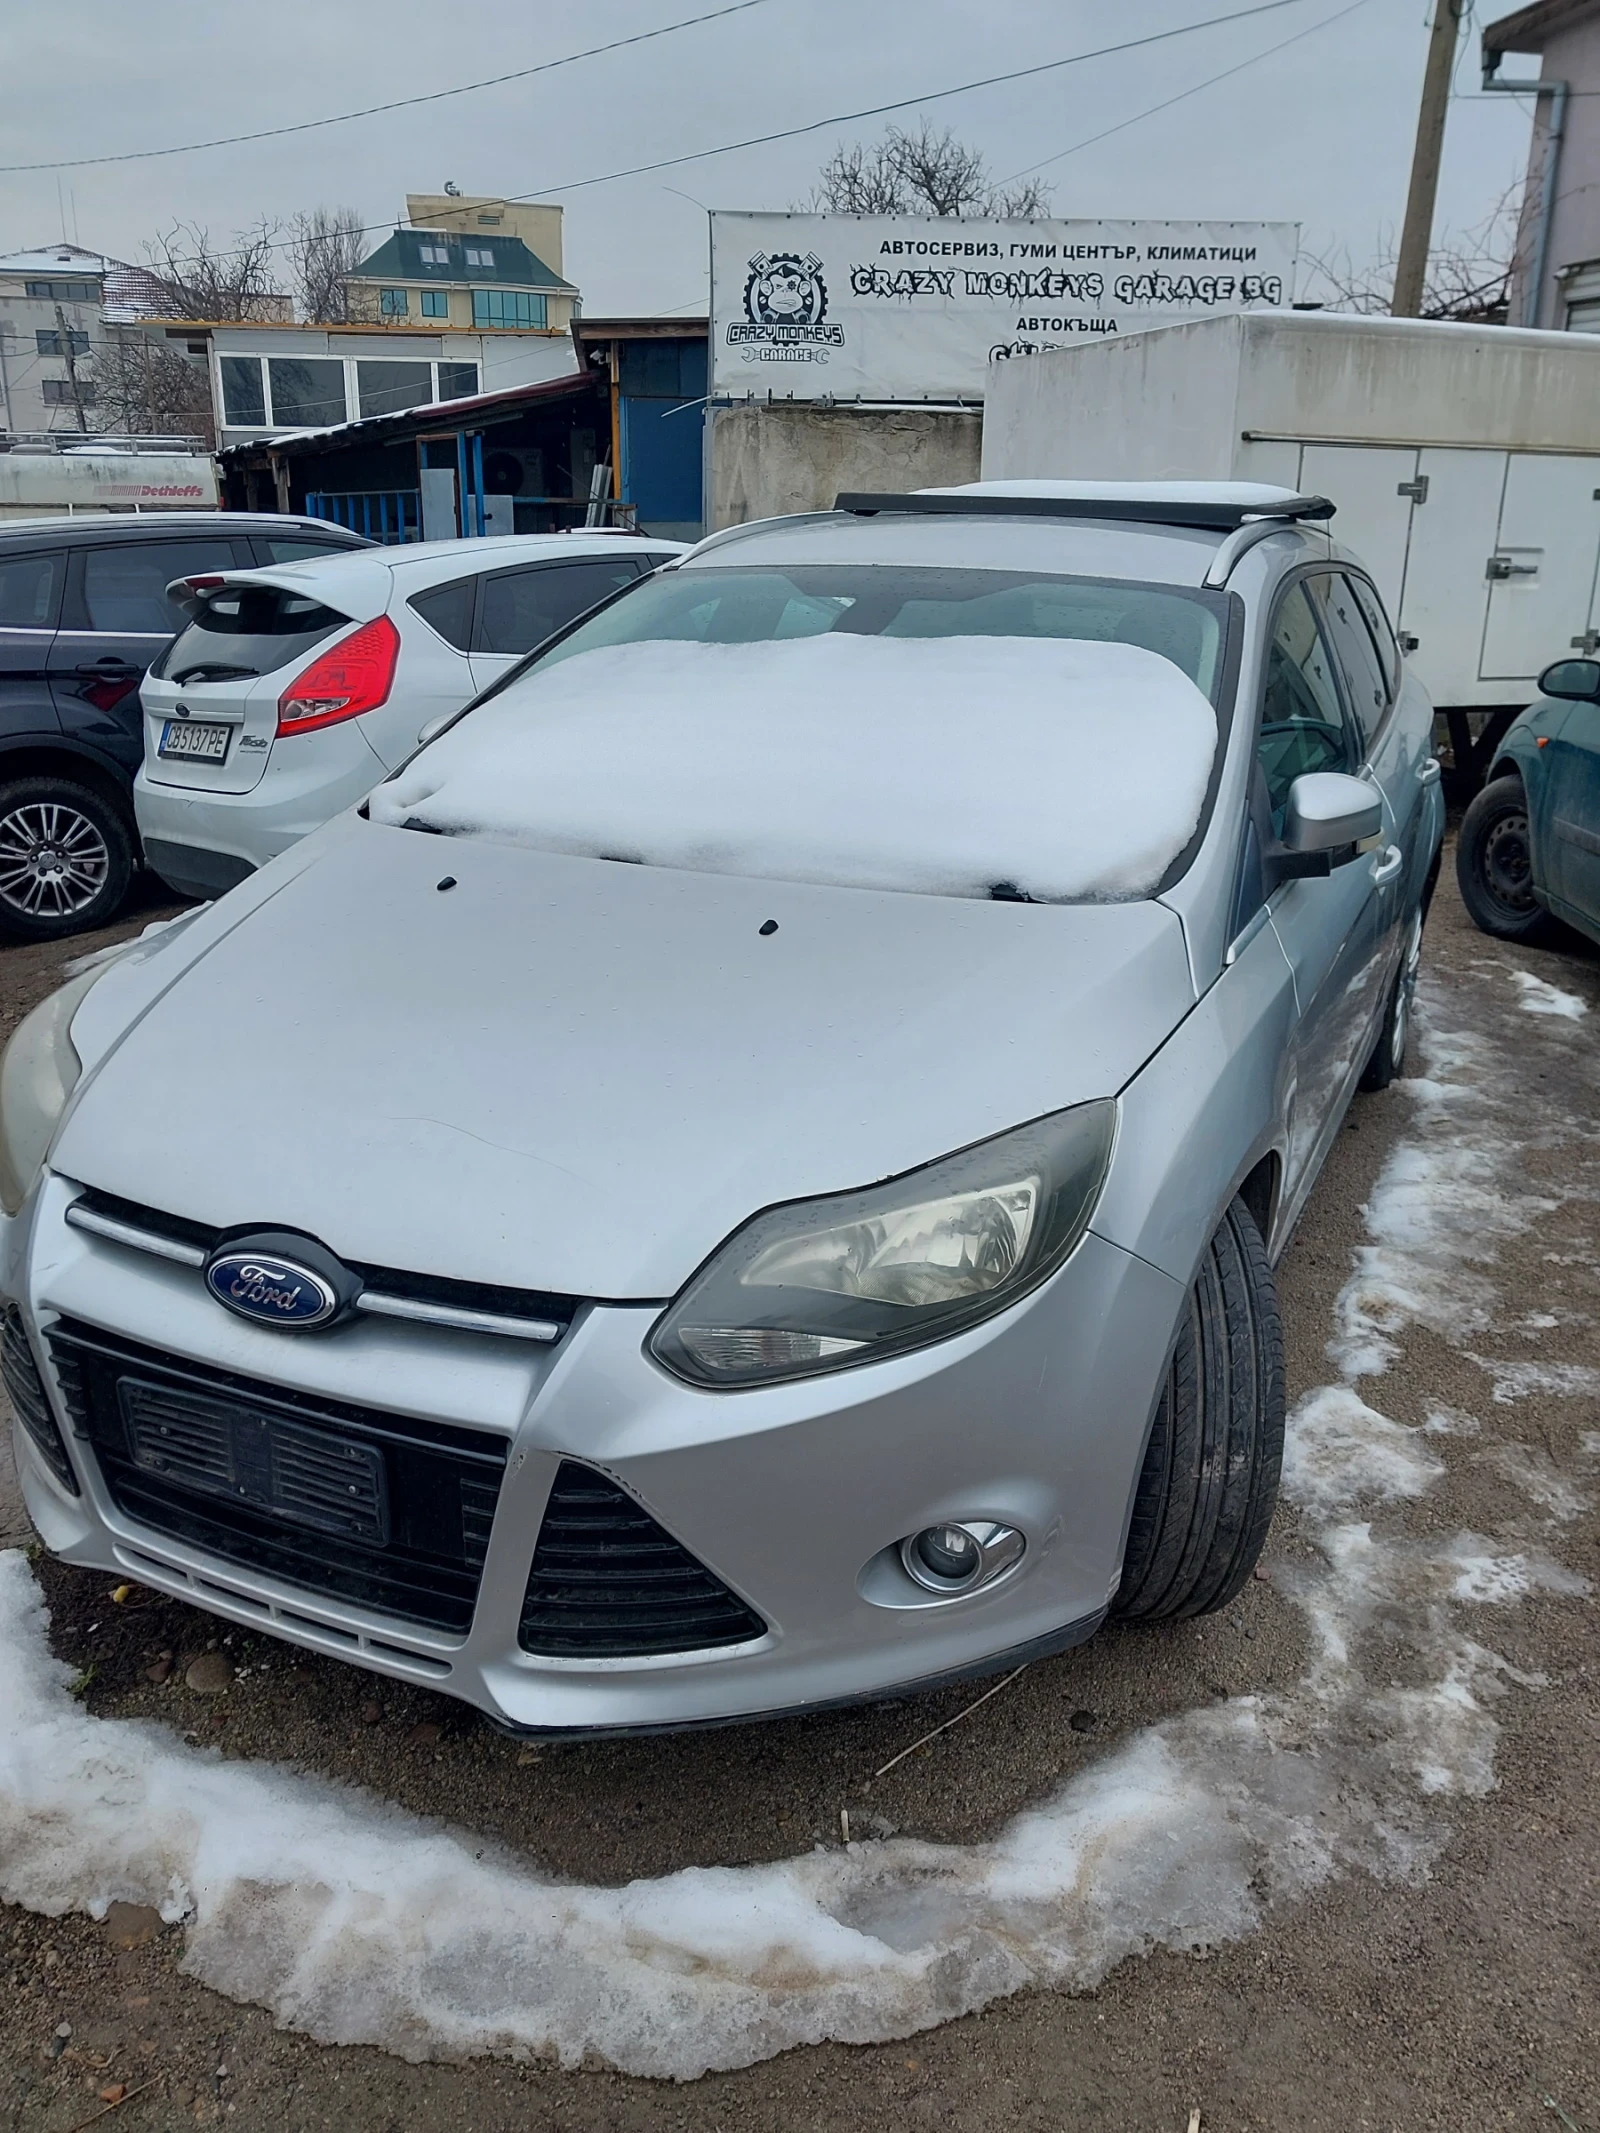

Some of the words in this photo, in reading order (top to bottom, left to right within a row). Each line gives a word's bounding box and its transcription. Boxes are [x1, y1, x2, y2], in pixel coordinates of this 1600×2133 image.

[879, 240, 1004, 260] АВТОСЕРВИЗ,
[1009, 243, 1057, 258] ГУМИ
[1062, 245, 1142, 262] ЦЕНТЪР,
[1147, 246, 1257, 262] КЛИМАТИЦИ
[850, 267, 955, 299] CRAZY
[965, 268, 1104, 301] MONKEYS
[1114, 273, 1235, 305] GARAGE
[1241, 275, 1282, 305] BG
[729, 324, 775, 342] CRAZY
[777, 325, 842, 344] MONKEYS
[1016, 317, 1118, 333] АВТОКЪЩА
[760, 348, 811, 361] GARAGE
[141, 485, 204, 497] Dethleffs
[230, 1265, 302, 1310] Ford
